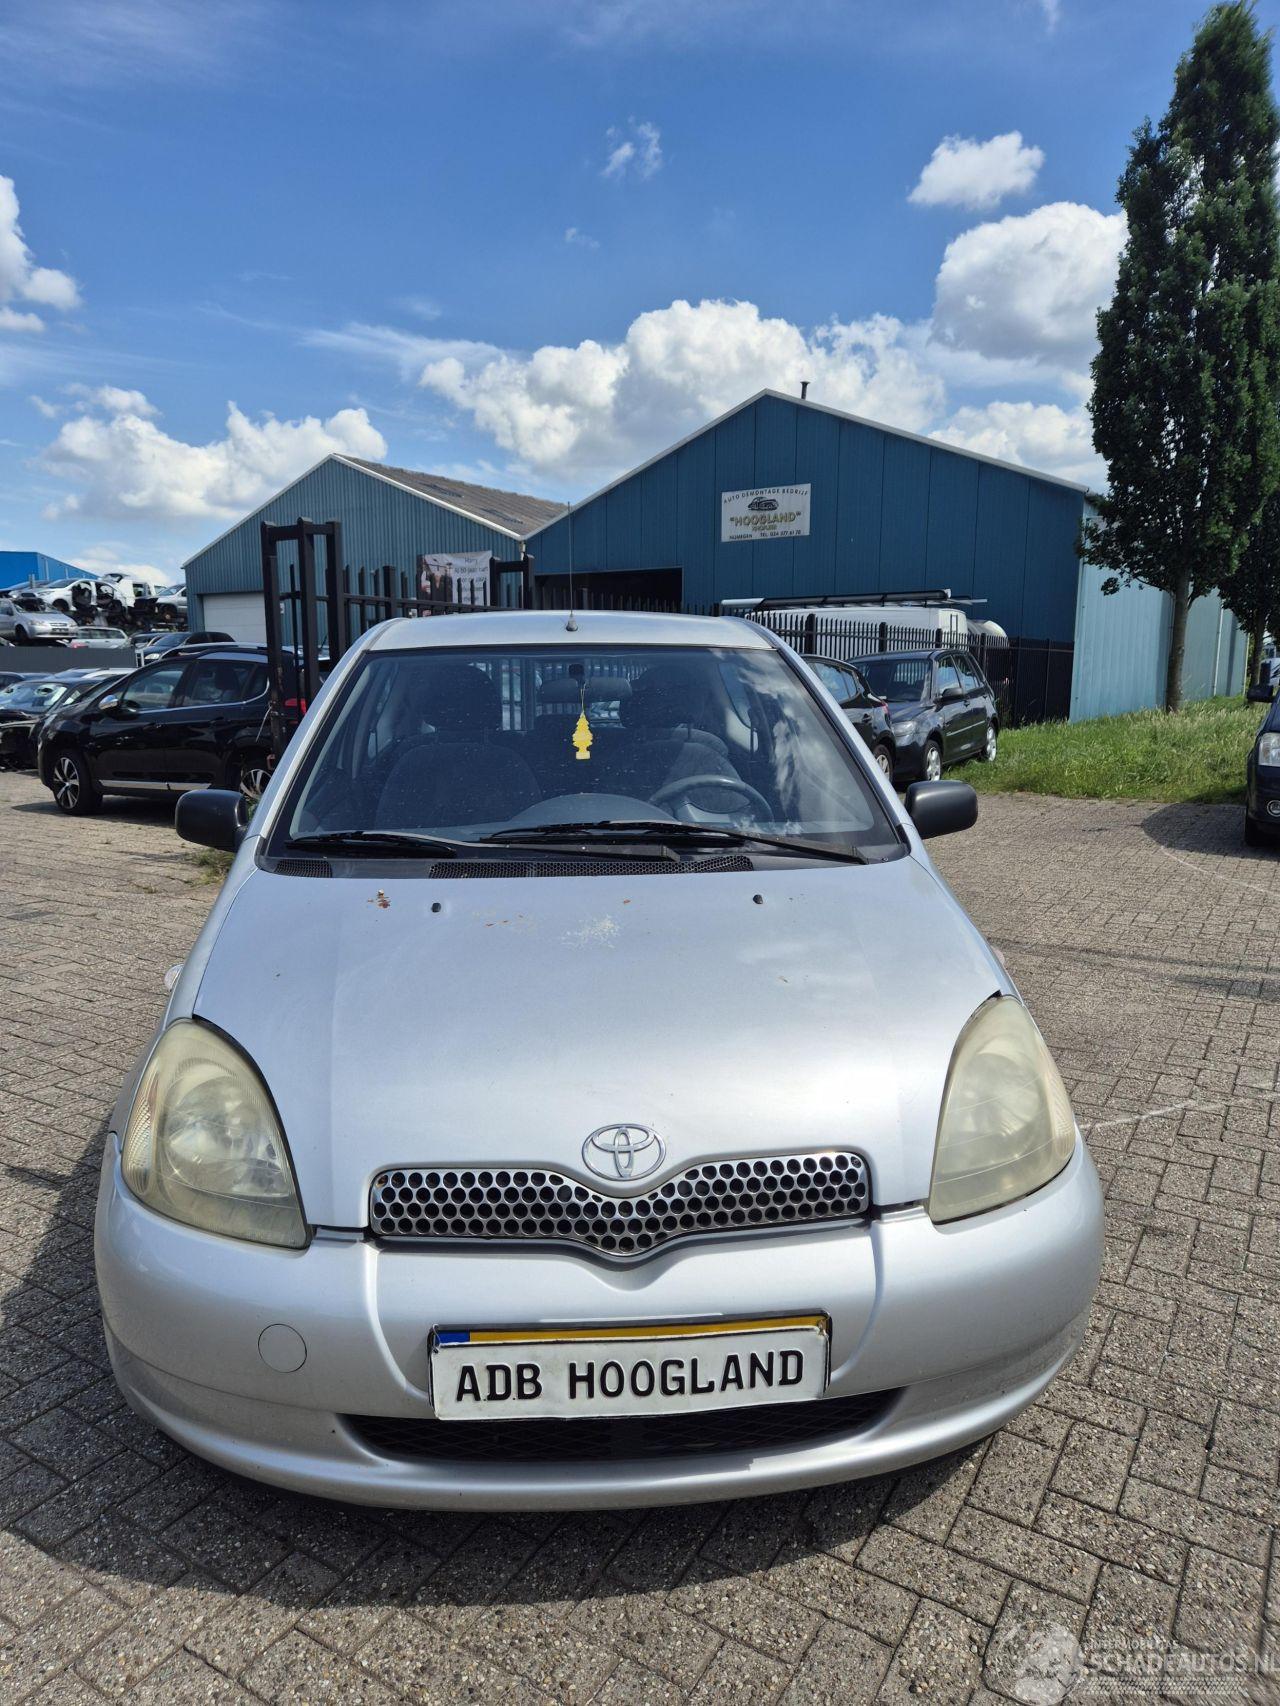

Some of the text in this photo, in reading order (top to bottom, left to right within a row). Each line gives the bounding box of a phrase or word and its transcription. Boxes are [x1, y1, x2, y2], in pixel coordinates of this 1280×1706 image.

[724, 494, 740, 503] AUTO
[742, 489, 780, 497] DEMONTAGE
[568, 1350, 804, 1399] HOOGLAND
